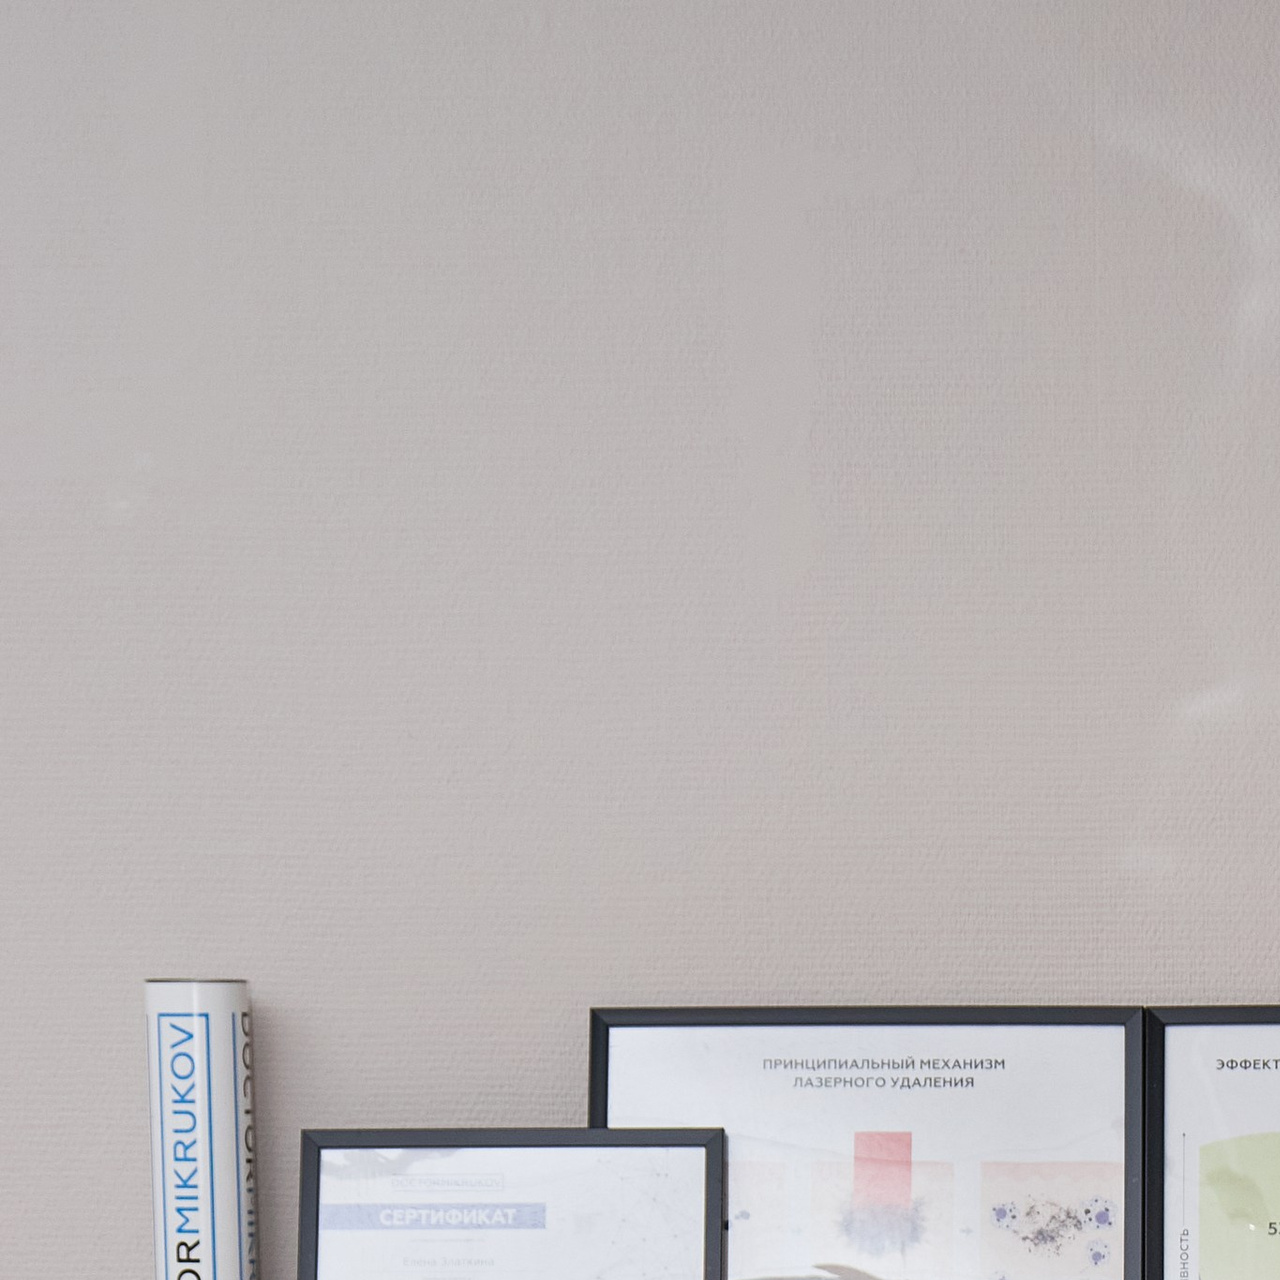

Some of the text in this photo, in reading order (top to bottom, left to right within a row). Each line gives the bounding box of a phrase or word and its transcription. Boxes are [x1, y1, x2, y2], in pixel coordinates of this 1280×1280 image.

[762, 1055, 1006, 1073] ПРИНЦИПИАЛЬНЫЙ МЕХАНИЗМ
[792, 1076, 975, 1090] ЛАЗЕРНОГО УДАЛЕНИЯ
[379, 1208, 518, 1227] СЕРТИФИКАТ
